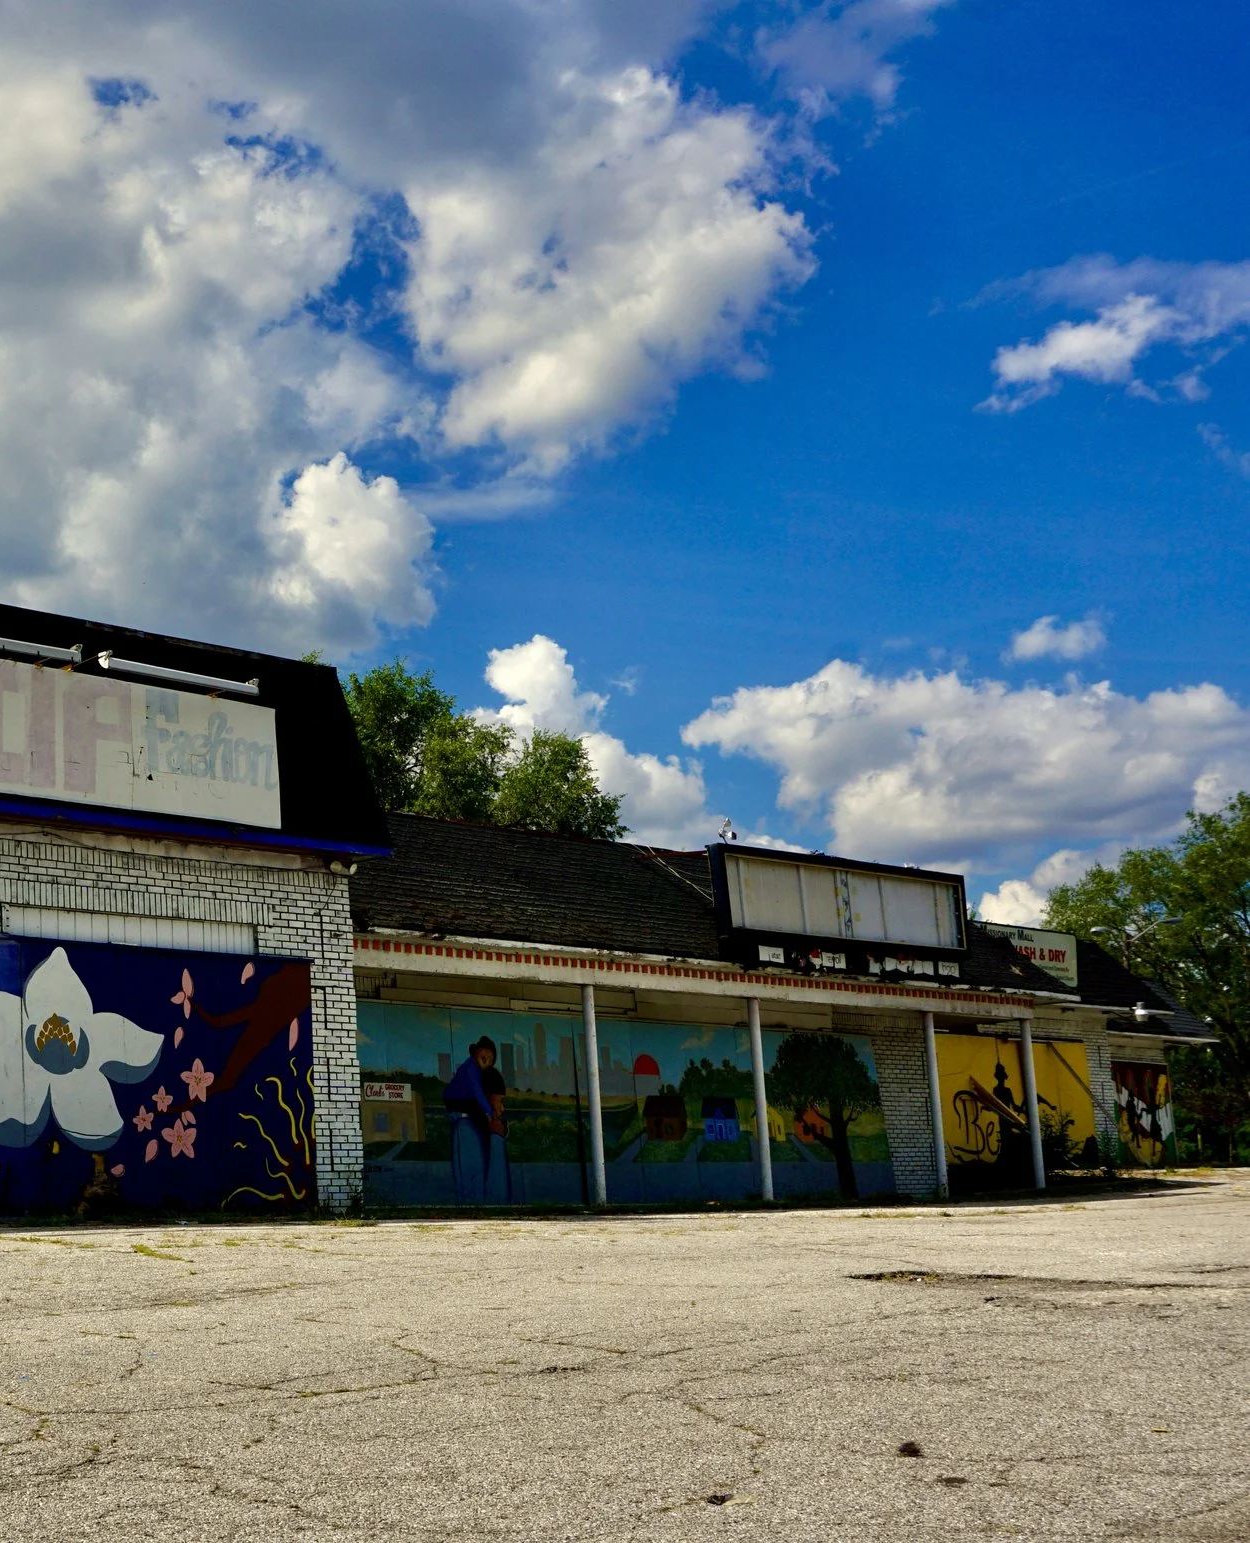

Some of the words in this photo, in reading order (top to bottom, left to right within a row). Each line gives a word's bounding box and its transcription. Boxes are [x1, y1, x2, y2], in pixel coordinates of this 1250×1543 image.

[1017, 930, 1034, 942] MALL
[1039, 948, 1045, 961] &
[1048, 949, 1067, 963] DRY
